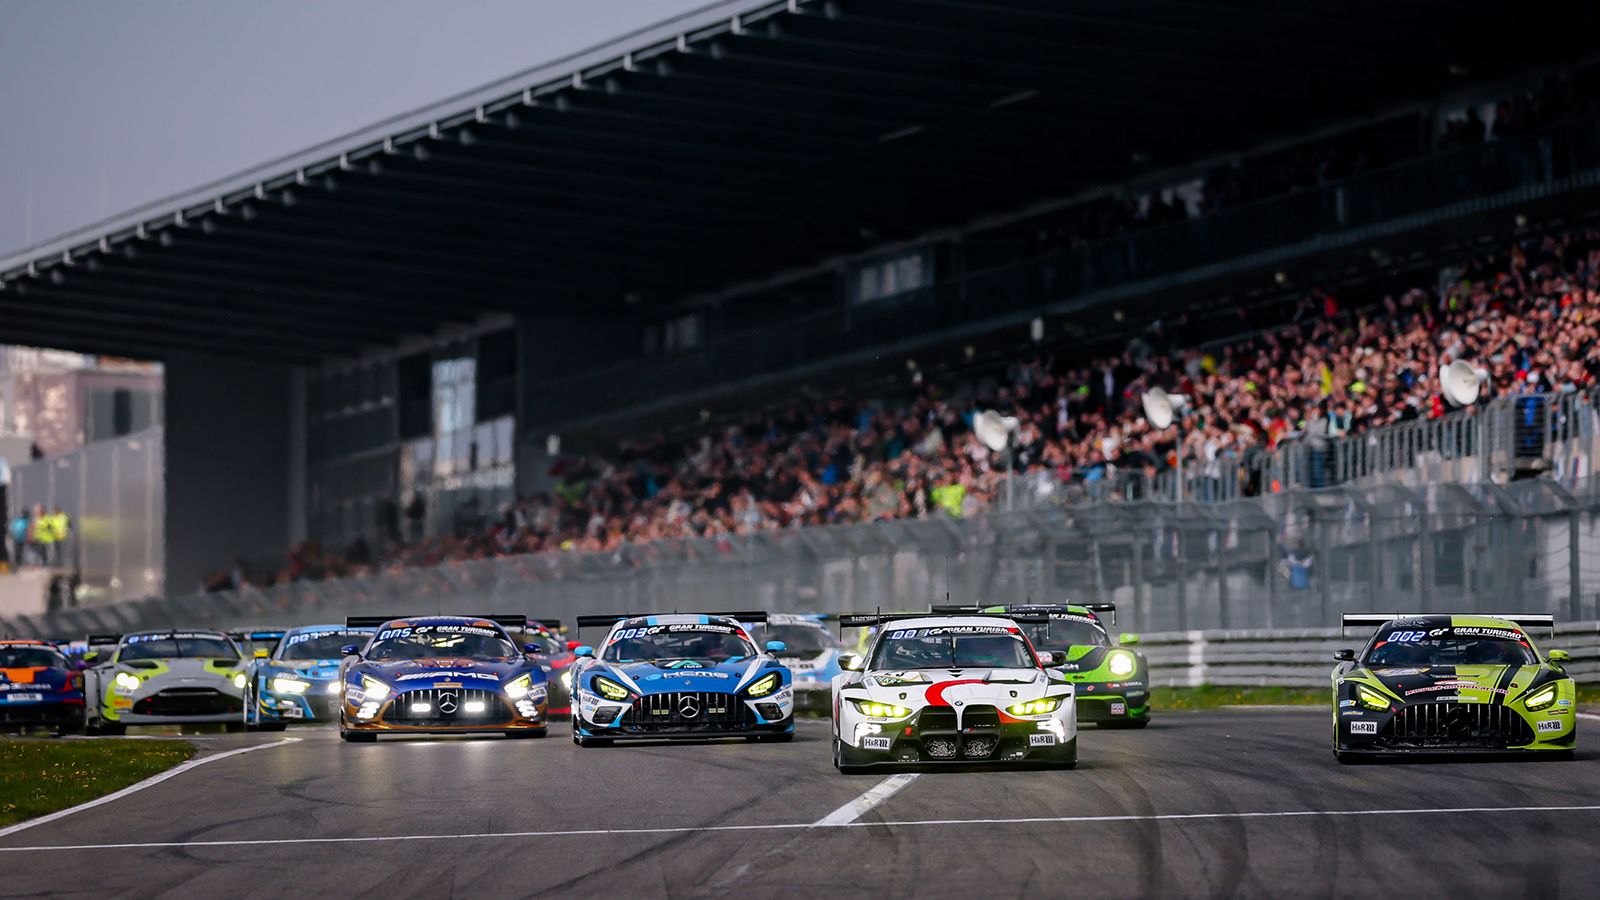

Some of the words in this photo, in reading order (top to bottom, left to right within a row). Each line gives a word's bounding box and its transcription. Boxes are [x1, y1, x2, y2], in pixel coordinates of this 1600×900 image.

[461, 627, 496, 636] TURISMO
[613, 628, 648, 640] 003
[694, 625, 731, 633] TURISMO
[1482, 628, 1522, 639] TURISMO
[1387, 631, 1426, 642] 002
[434, 671, 499, 681] AMG
